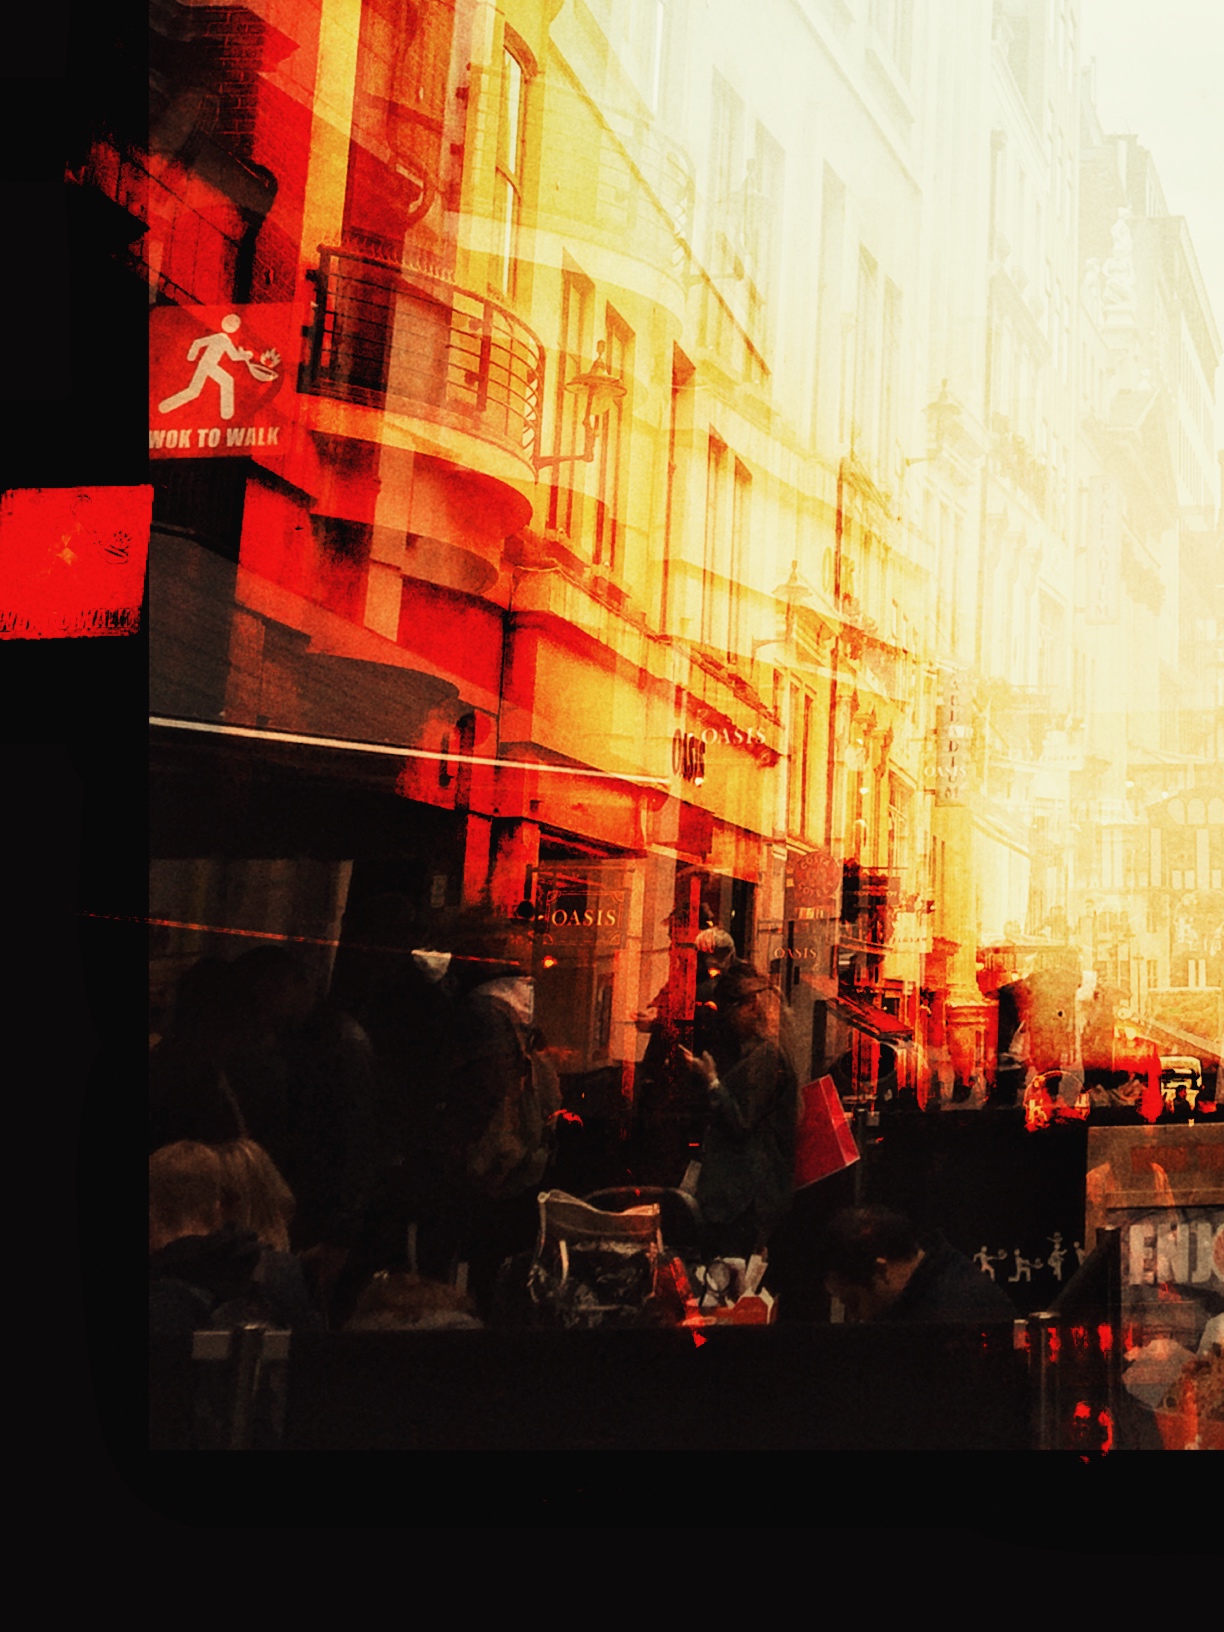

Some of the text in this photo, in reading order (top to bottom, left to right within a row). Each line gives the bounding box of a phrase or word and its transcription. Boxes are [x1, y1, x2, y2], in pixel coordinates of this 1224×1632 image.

[149, 426, 280, 449] WOK TO WALK
[701, 727, 766, 745] OASIS
[924, 765, 967, 778] OASIS
[551, 909, 617, 927] OASIS
[773, 947, 817, 960] OASIS
